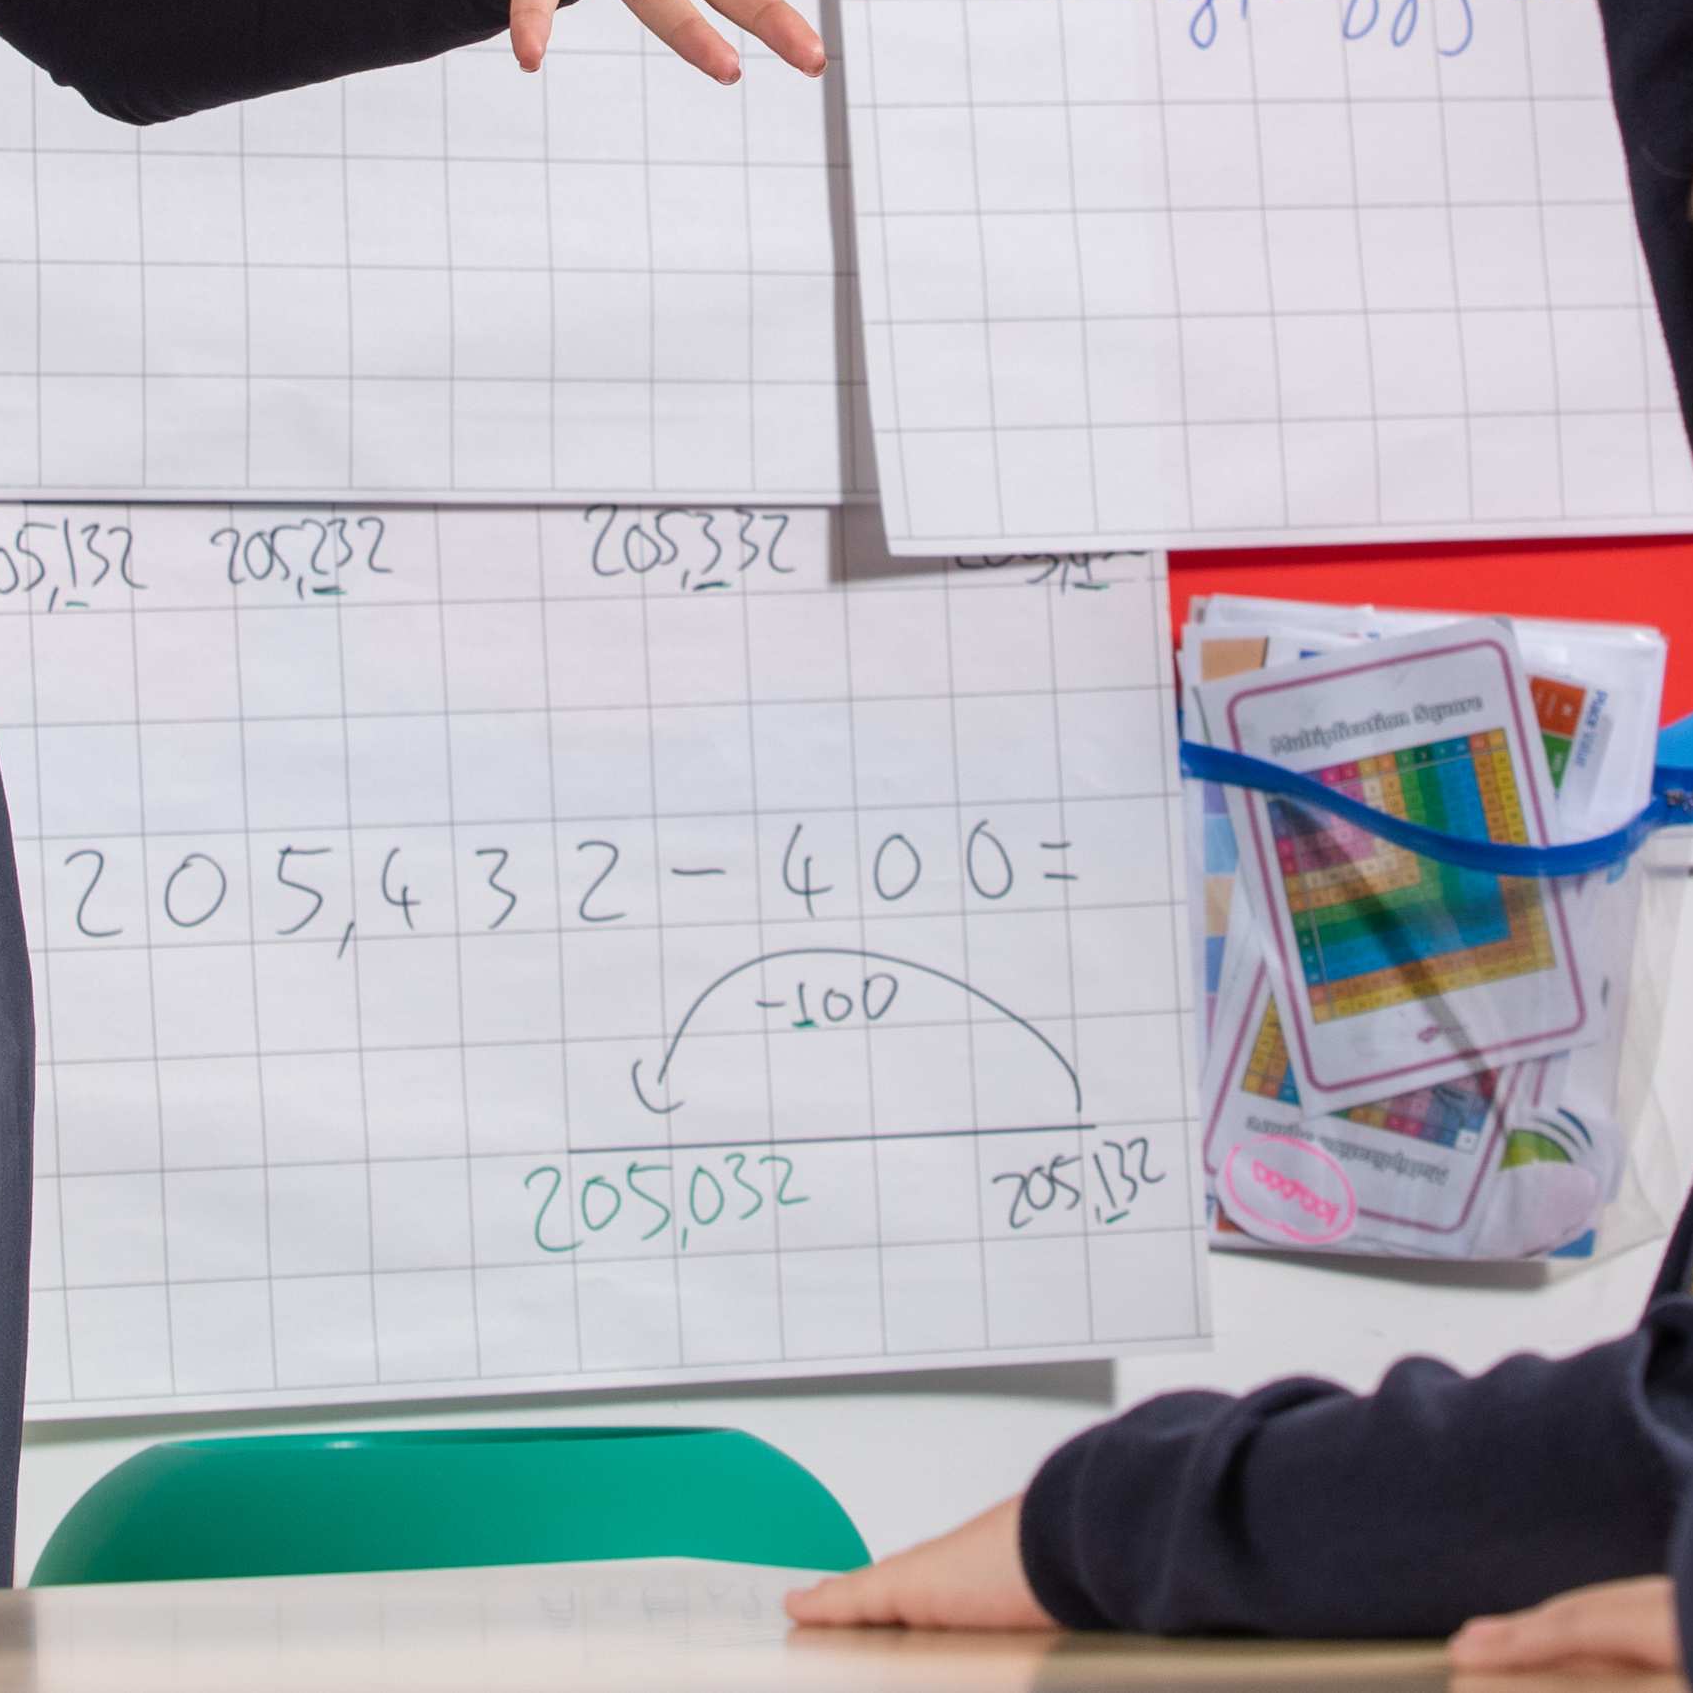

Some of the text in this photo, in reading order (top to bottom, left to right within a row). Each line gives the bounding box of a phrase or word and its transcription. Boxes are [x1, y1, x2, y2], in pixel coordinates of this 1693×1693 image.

[209, 516, 394, 600] 205,232
[523, 1153, 810, 1253] 205,032
[992, 1137, 1168, 1230] 205,132
